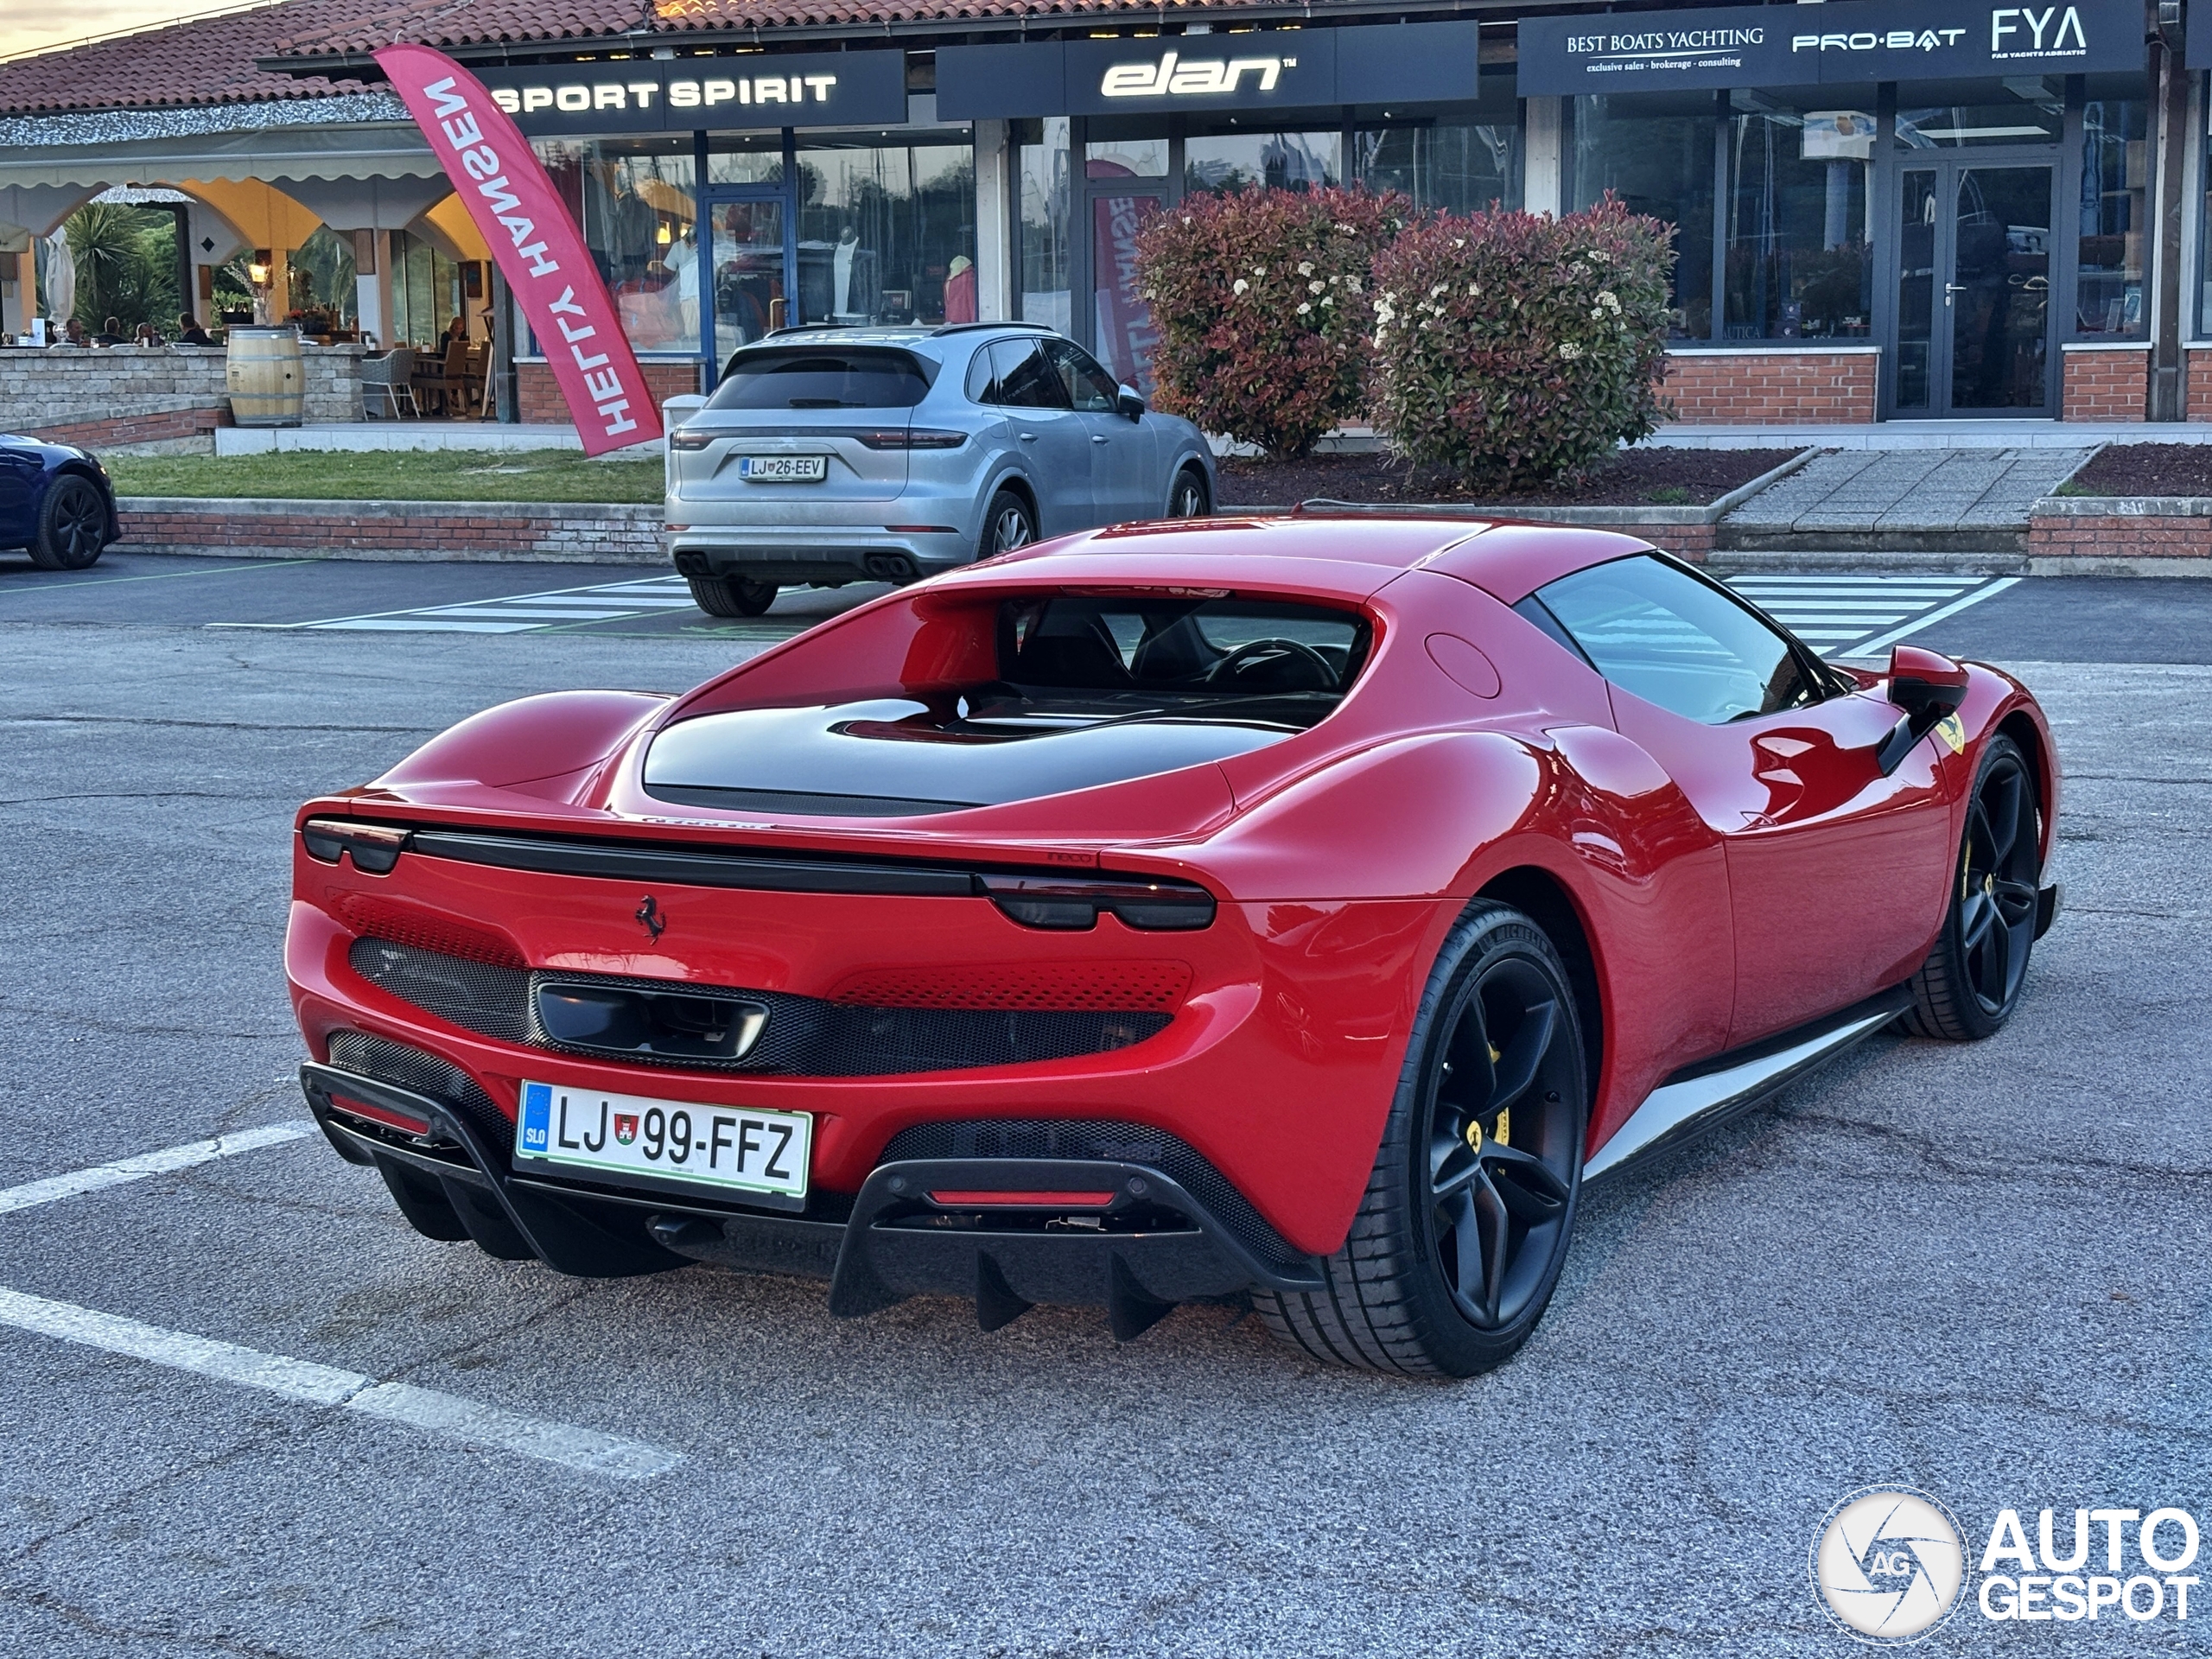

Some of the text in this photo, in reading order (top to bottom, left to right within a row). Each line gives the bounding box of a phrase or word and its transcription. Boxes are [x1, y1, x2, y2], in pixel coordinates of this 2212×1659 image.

[1567, 28, 1764, 53] BEST BOATS YACHTING
[1992, 7, 2087, 51] FYA
[1101, 53, 1281, 97] elan
[1586, 57, 1741, 72] exclusive sales brokerage consulting
[491, 75, 836, 113] SPORT SPIRIT
[751, 460, 766, 474] LJ
[775, 460, 821, 474] 26-EEV
[1497, 925, 1548, 953] MICHELIN
[525, 1127, 545, 1146] SLO
[558, 1096, 793, 1179] LJ 99-FFZ
